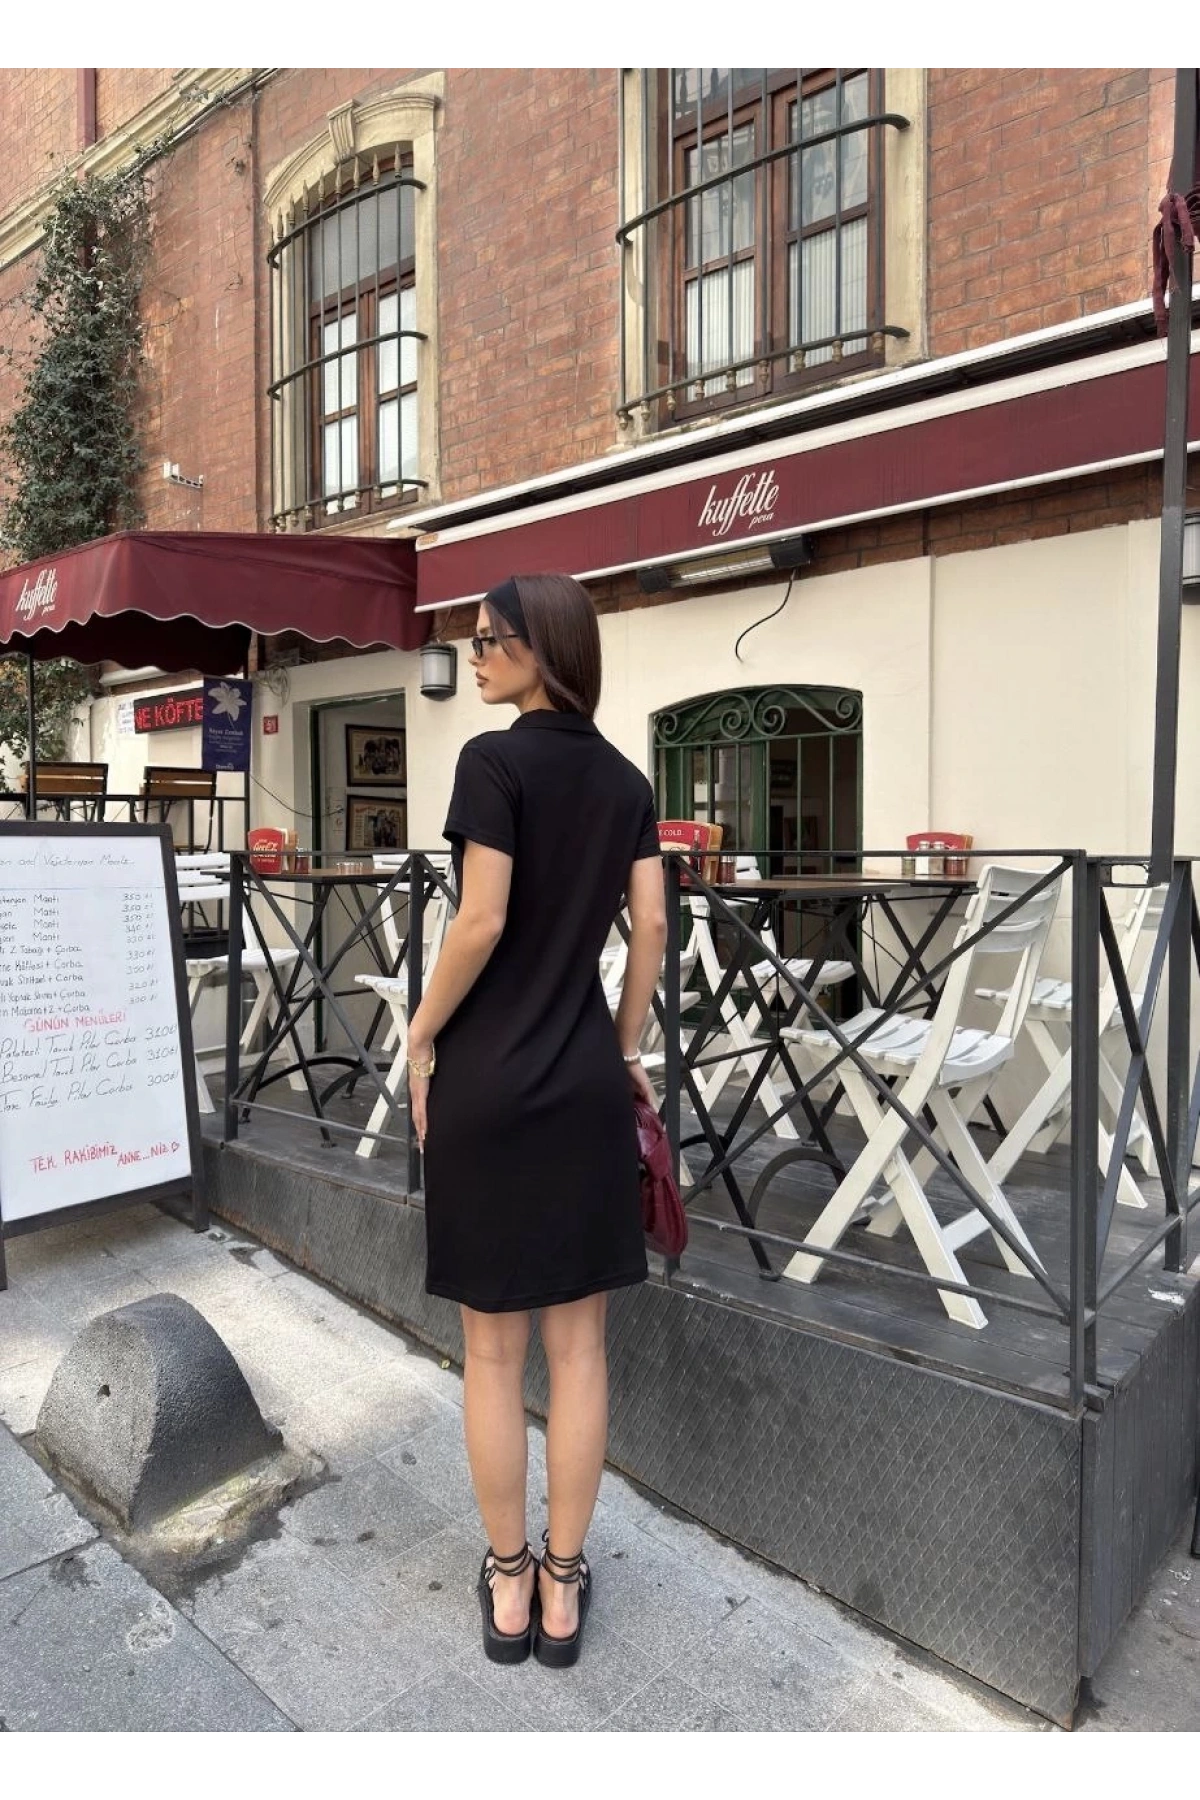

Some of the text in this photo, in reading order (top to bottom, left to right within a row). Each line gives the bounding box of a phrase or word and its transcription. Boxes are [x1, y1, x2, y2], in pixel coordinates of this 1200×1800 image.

[697, 469, 779, 537] kuffette
[15, 567, 58, 621] kuffette
[28, 1155, 57, 1174] TEK
